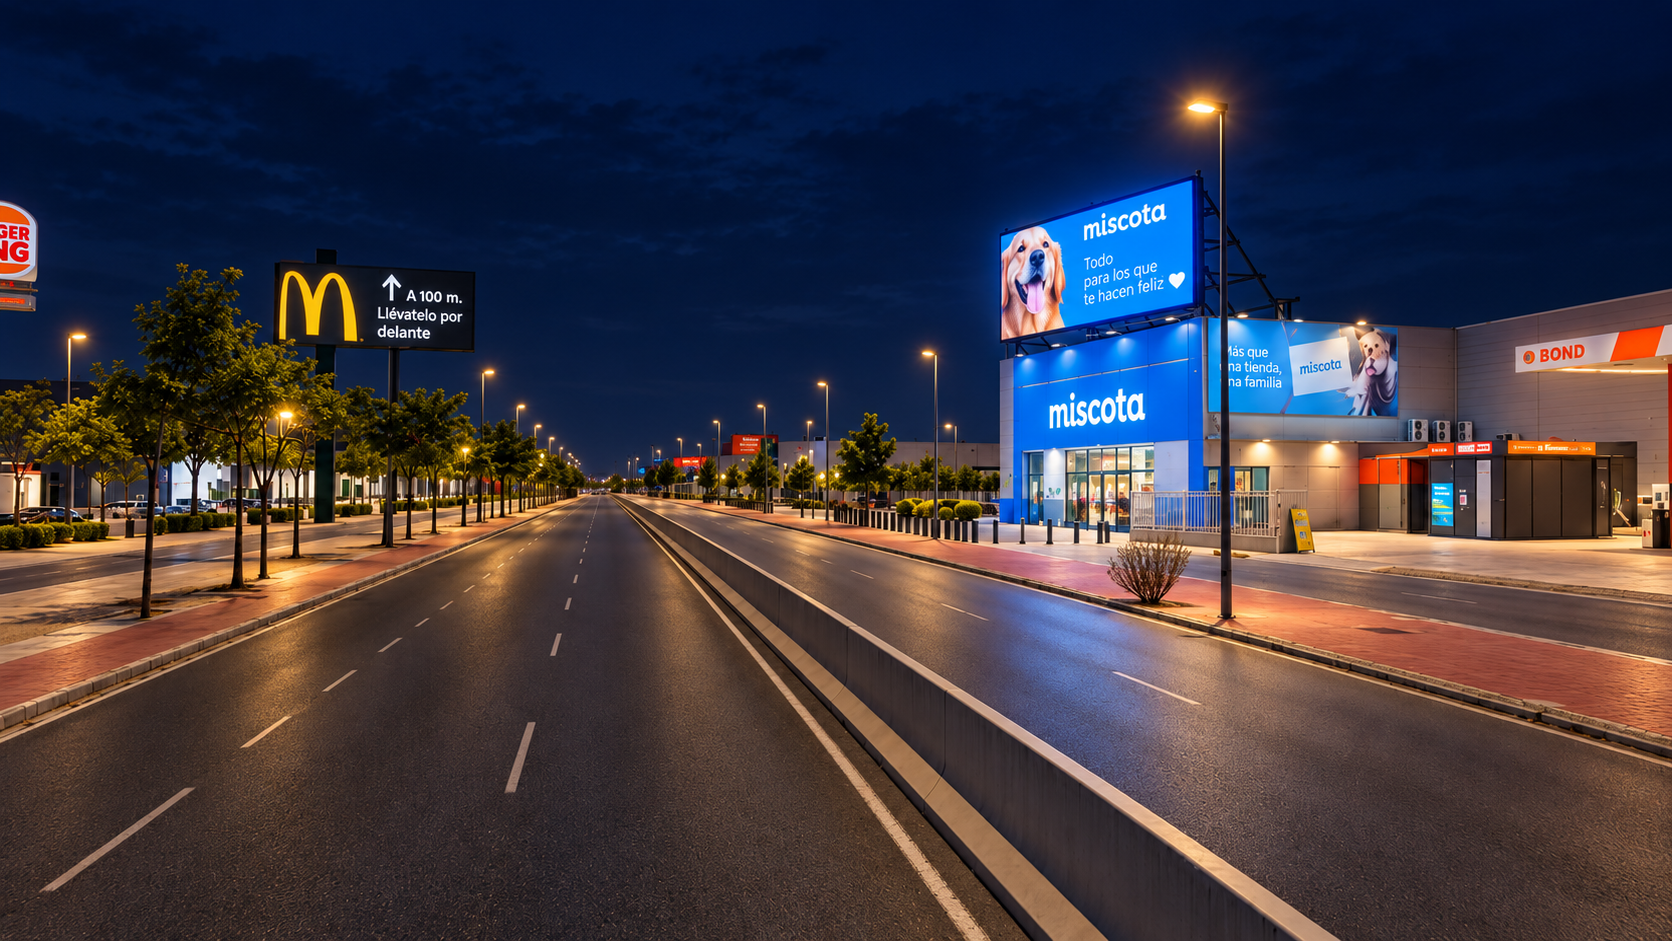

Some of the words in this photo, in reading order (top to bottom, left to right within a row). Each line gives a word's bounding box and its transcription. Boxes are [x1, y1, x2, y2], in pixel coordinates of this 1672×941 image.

[1084, 204, 1167, 241] miscota
[1084, 253, 1114, 270] Todo
[1084, 273, 1109, 291] para
[1113, 268, 1130, 281] los
[1133, 262, 1158, 279] que
[406, 289, 417, 302] A
[419, 290, 442, 303] 100
[446, 293, 463, 304] m.
[1084, 293, 1095, 305] te
[1098, 285, 1134, 302] hacen
[1138, 277, 1165, 294] feliz
[377, 306, 437, 322] Llévatelo
[440, 313, 463, 325] por
[377, 324, 431, 339] delante
[1247, 348, 1269, 360] que
[1539, 344, 1586, 363] BOND
[1220, 363, 1241, 372] na
[1244, 361, 1282, 375] tienda,
[1299, 359, 1342, 375] miscota
[1245, 376, 1282, 389] familia
[1049, 388, 1146, 429] miscota
